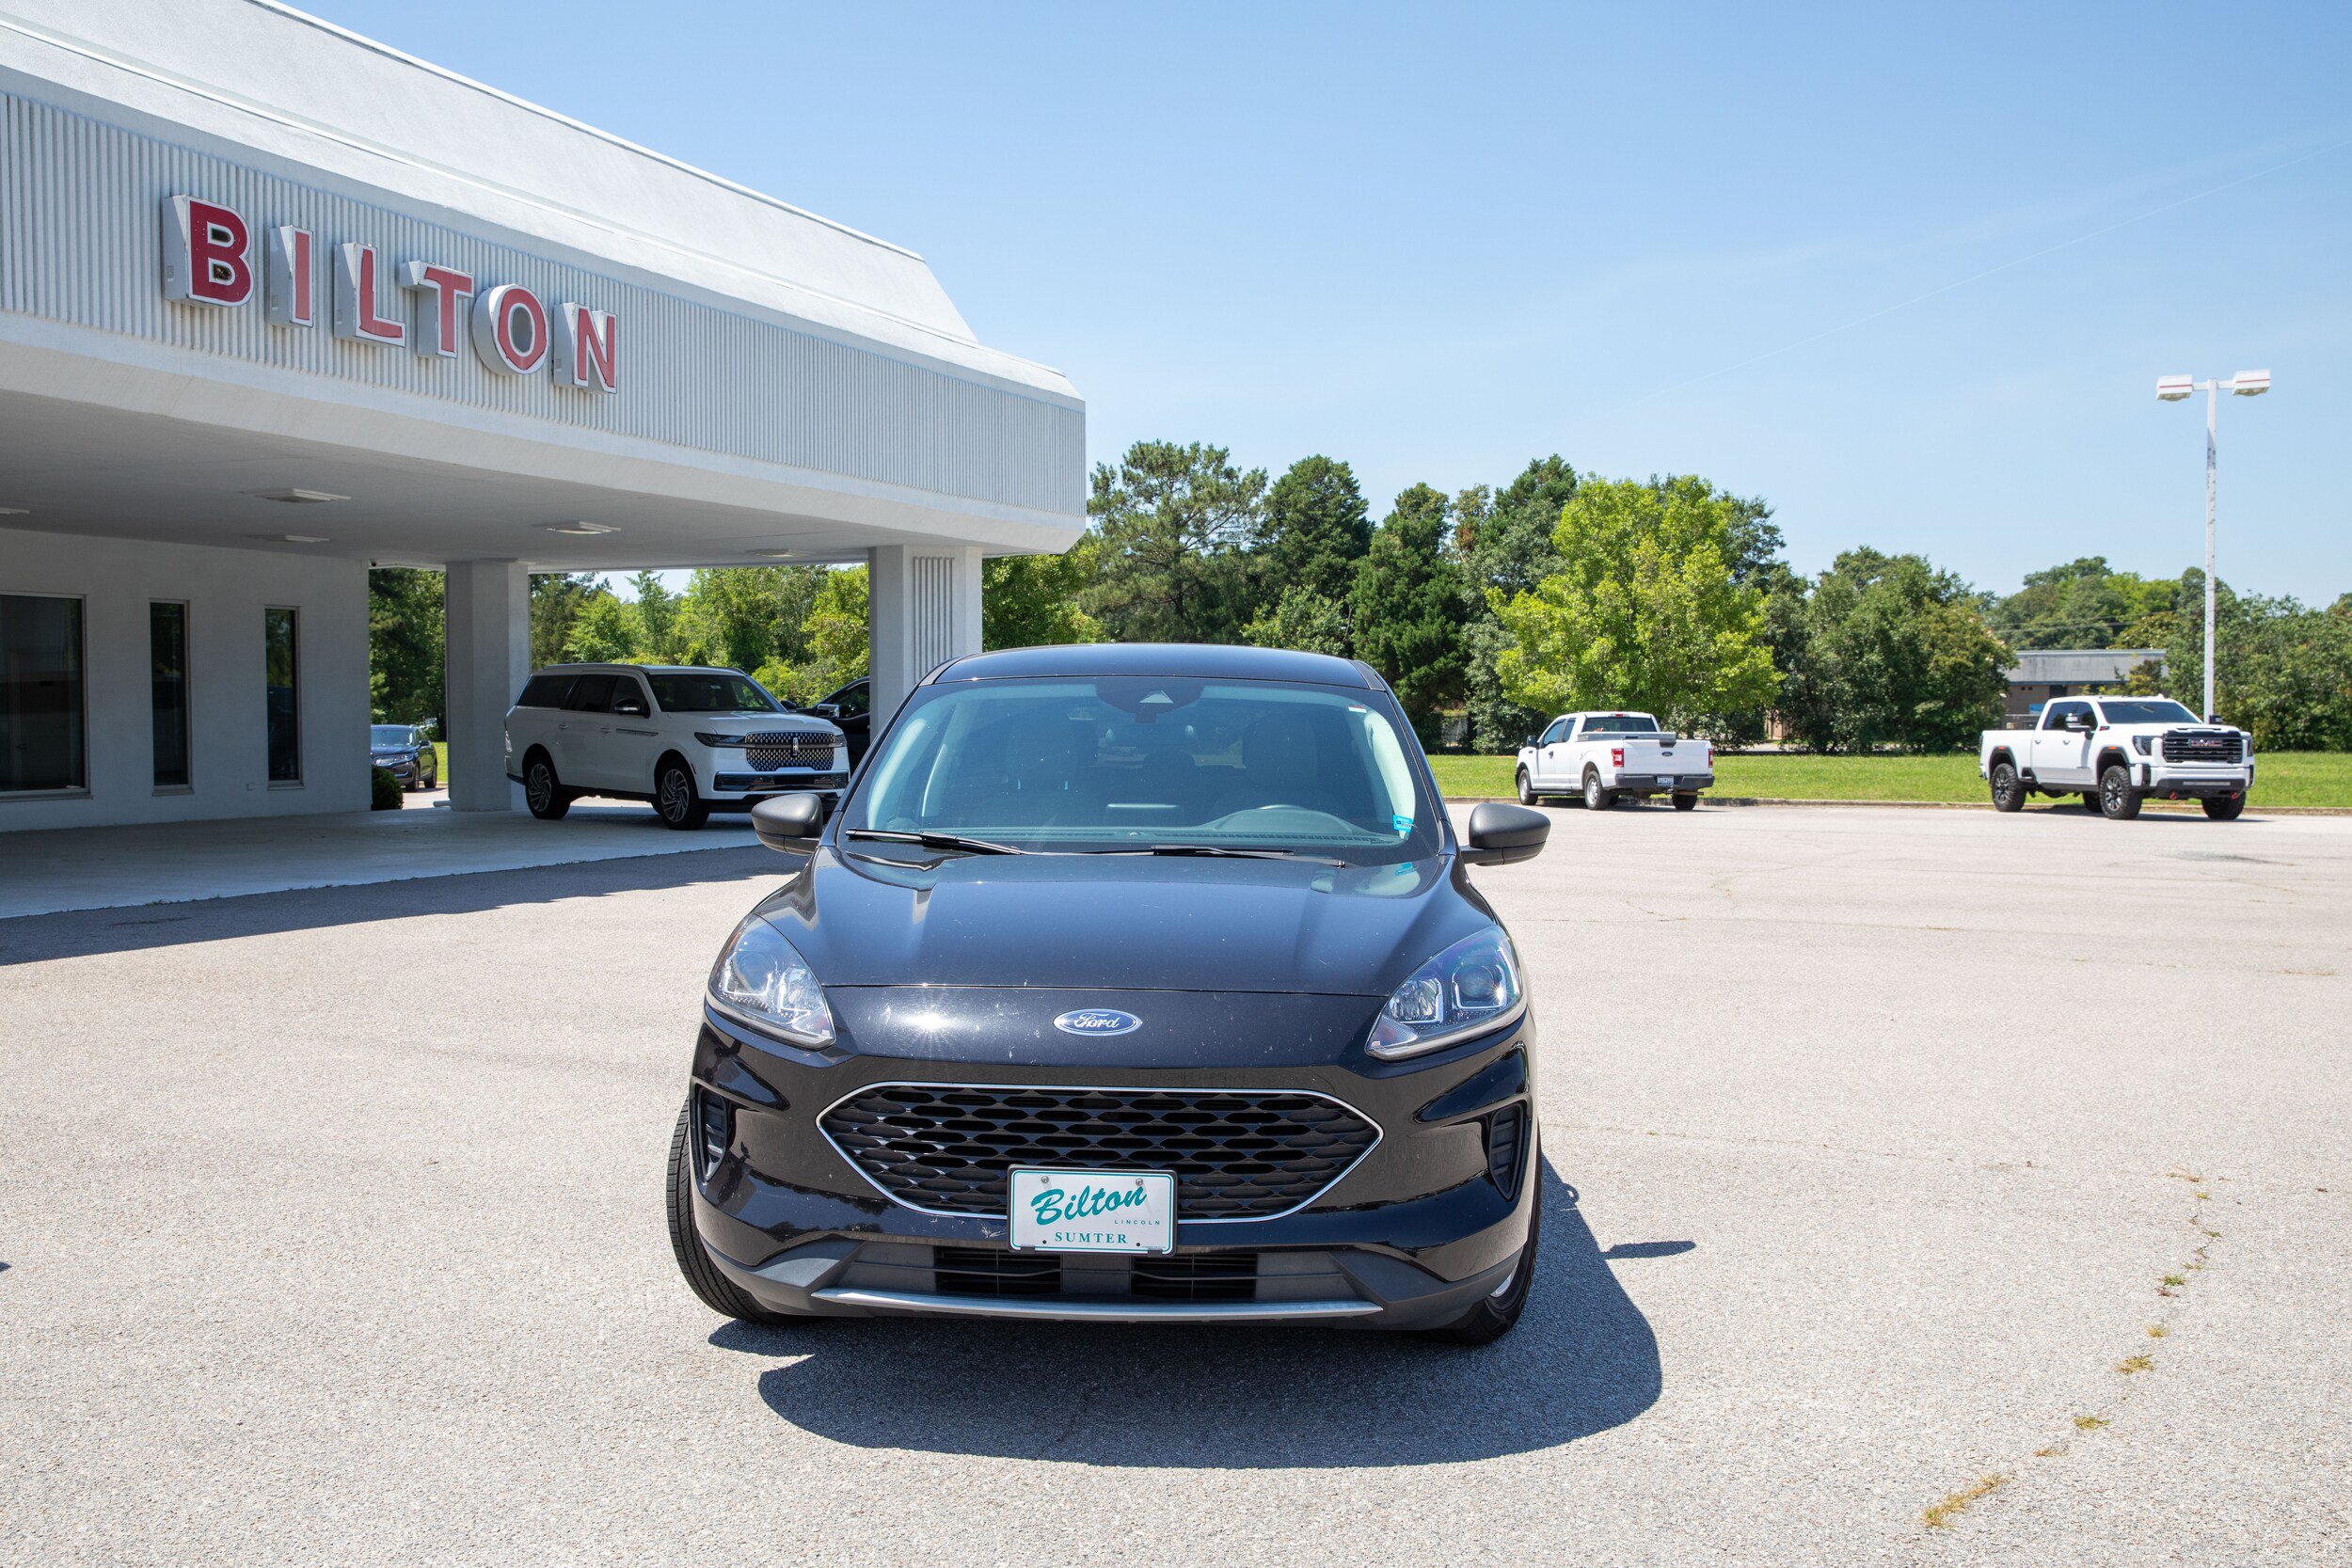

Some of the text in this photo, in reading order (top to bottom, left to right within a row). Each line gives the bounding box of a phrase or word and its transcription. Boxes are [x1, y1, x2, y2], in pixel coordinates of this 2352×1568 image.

[163, 194, 619, 394] BILTON
[1073, 1012, 1120, 1028] Ford
[1030, 1185, 1147, 1226] Bilton
[1055, 1231, 1127, 1243] SUMTER
